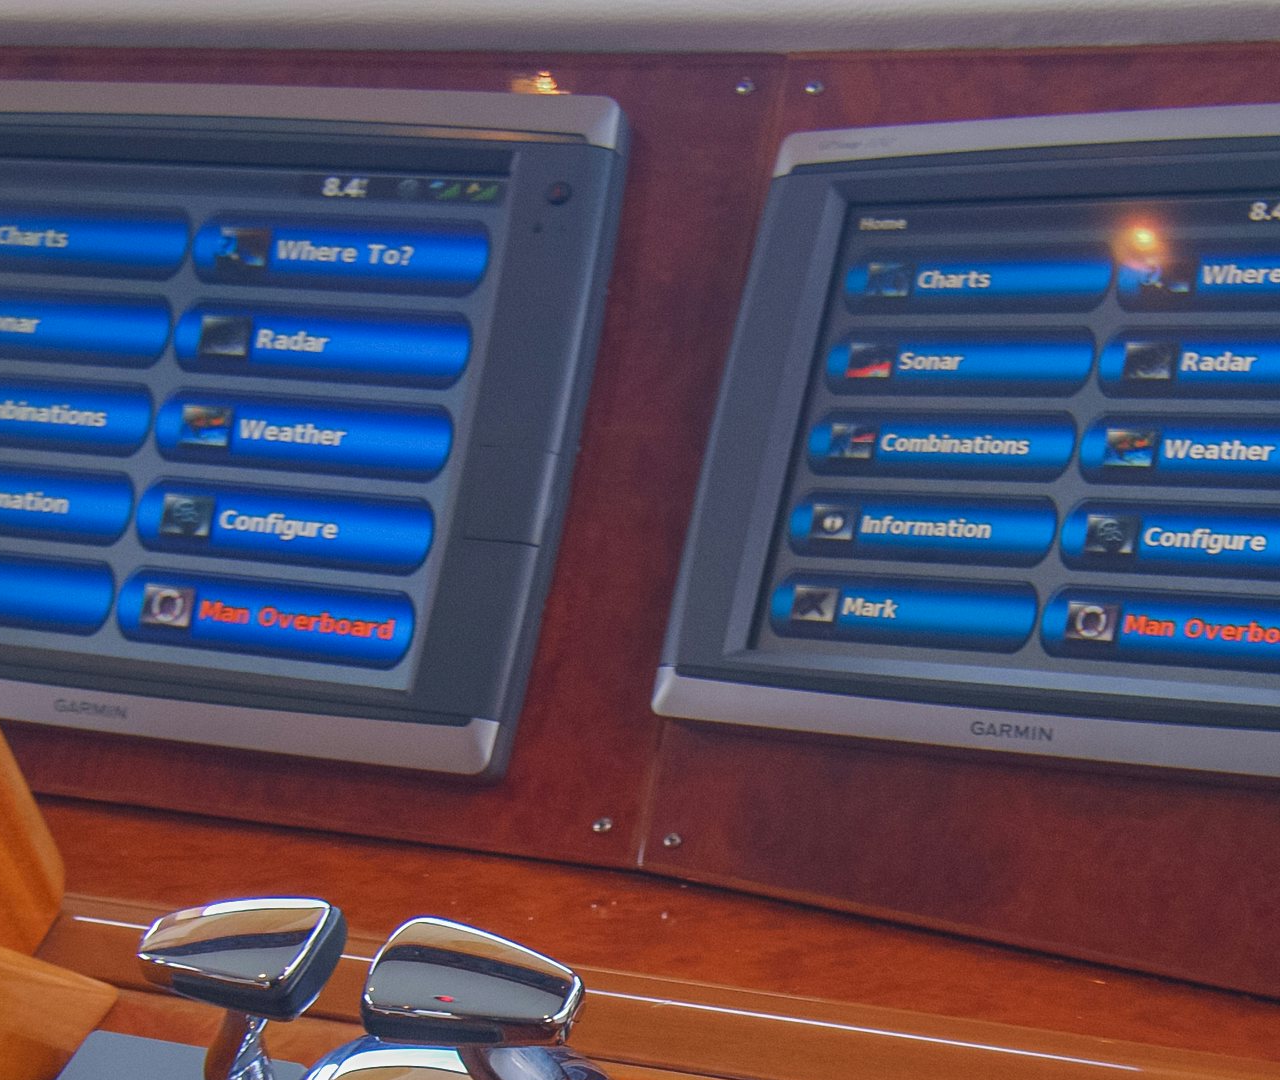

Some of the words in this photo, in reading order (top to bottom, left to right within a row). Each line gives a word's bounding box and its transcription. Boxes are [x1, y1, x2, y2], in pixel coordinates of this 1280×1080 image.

[859, 217, 908, 231] Home
[276, 239, 358, 263] Where
[368, 244, 415, 267] To?
[917, 269, 991, 290] Charts
[255, 328, 331, 353] Radar
[898, 352, 965, 372] Sonar
[1180, 351, 1258, 372] Radar
[239, 418, 348, 446] Weather
[881, 432, 1030, 456] Combinations
[1163, 438, 1276, 461] Weather
[220, 509, 339, 541] Configure
[861, 515, 992, 539] Information
[1143, 527, 1268, 554] Configure
[199, 599, 250, 625] Man
[258, 607, 397, 640] Overboard
[841, 597, 899, 619] Mark
[1123, 614, 1175, 637] Man
[53, 698, 127, 719] GARMIN
[970, 720, 1054, 742] GARMIN
